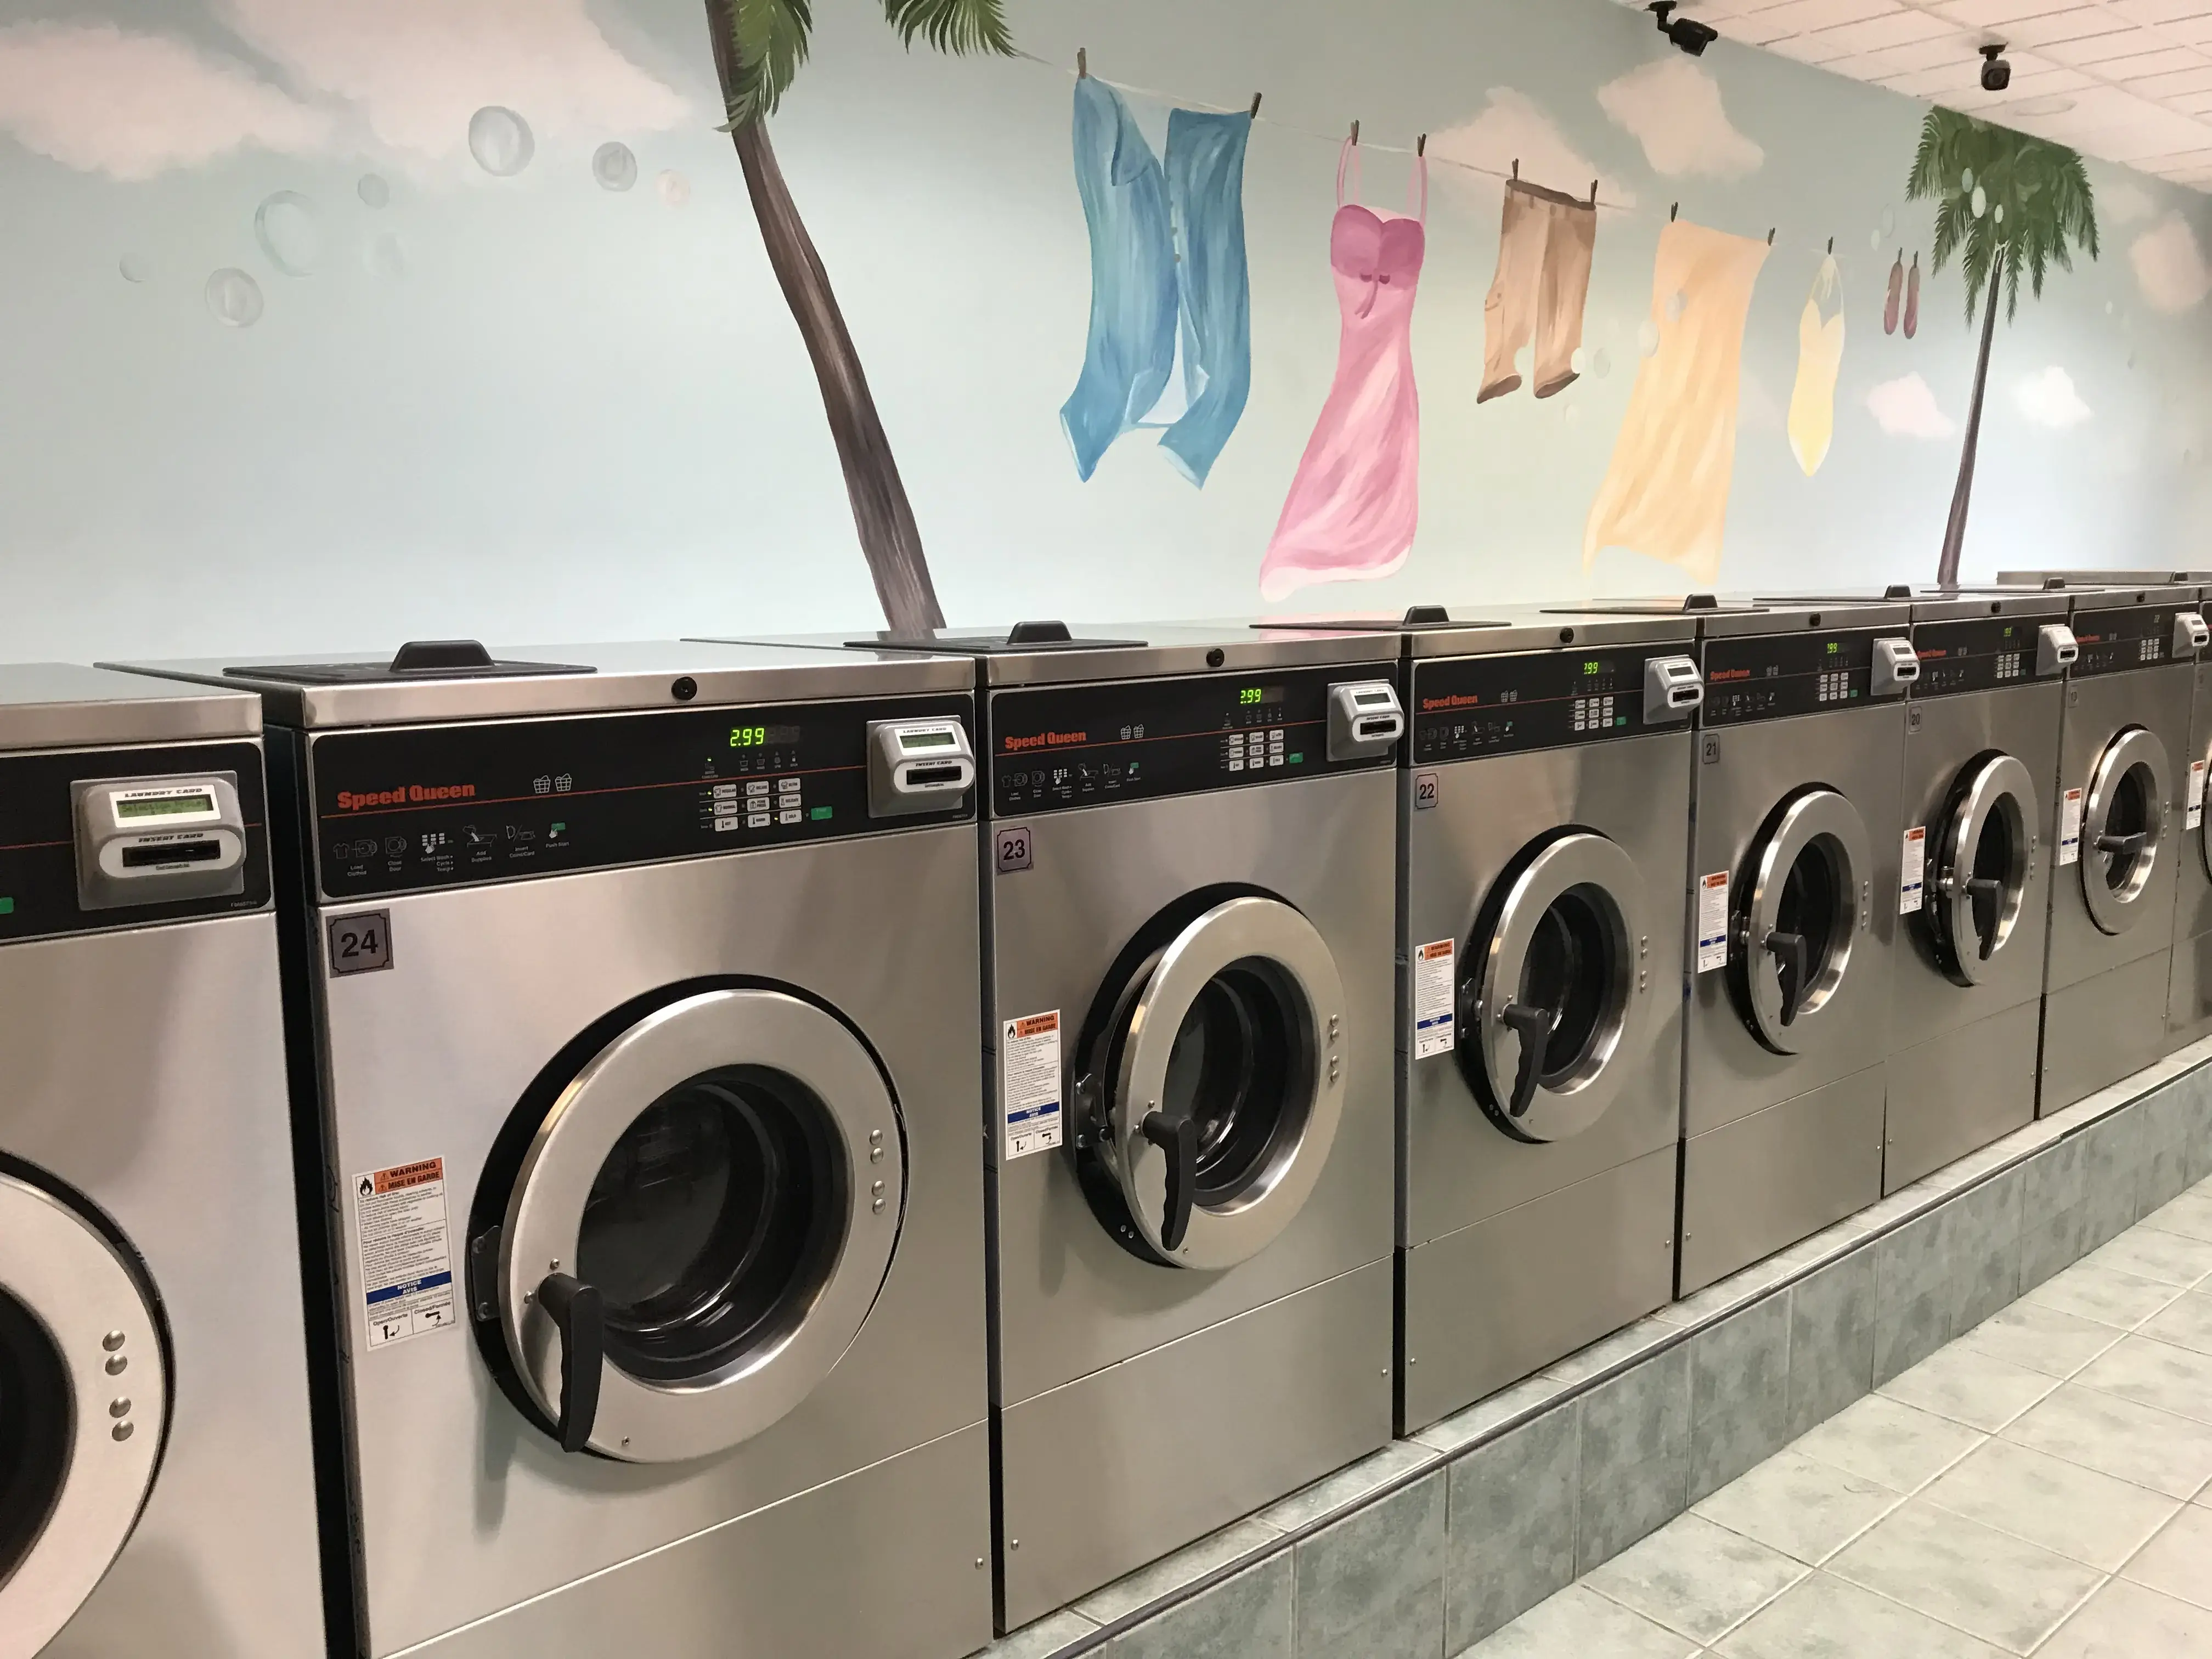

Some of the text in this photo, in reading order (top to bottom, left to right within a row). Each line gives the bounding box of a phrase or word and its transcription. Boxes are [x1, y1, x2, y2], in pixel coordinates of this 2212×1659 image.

[1240, 689, 1261, 704] 2.99
[1423, 695, 1478, 710] Speed Queen
[1911, 713, 1920, 725] 20
[730, 727, 765, 747] 2.99
[1005, 731, 1087, 751] Speed Queen
[1706, 741, 1716, 756] 21
[337, 783, 475, 810] Speed Queen
[1419, 783, 1435, 800] 22
[1003, 839, 1025, 860] 23
[341, 929, 378, 958] 24
[1026, 1015, 1054, 1026] WARNING
[390, 1161, 436, 1177] WARNING
[388, 1180, 404, 1189] MISE
[417, 1171, 439, 1182] GARDE
[397, 1279, 422, 1290] NOTICE
[403, 1286, 417, 1295] AVIS
[373, 1313, 408, 1326] Open/Ouverte
